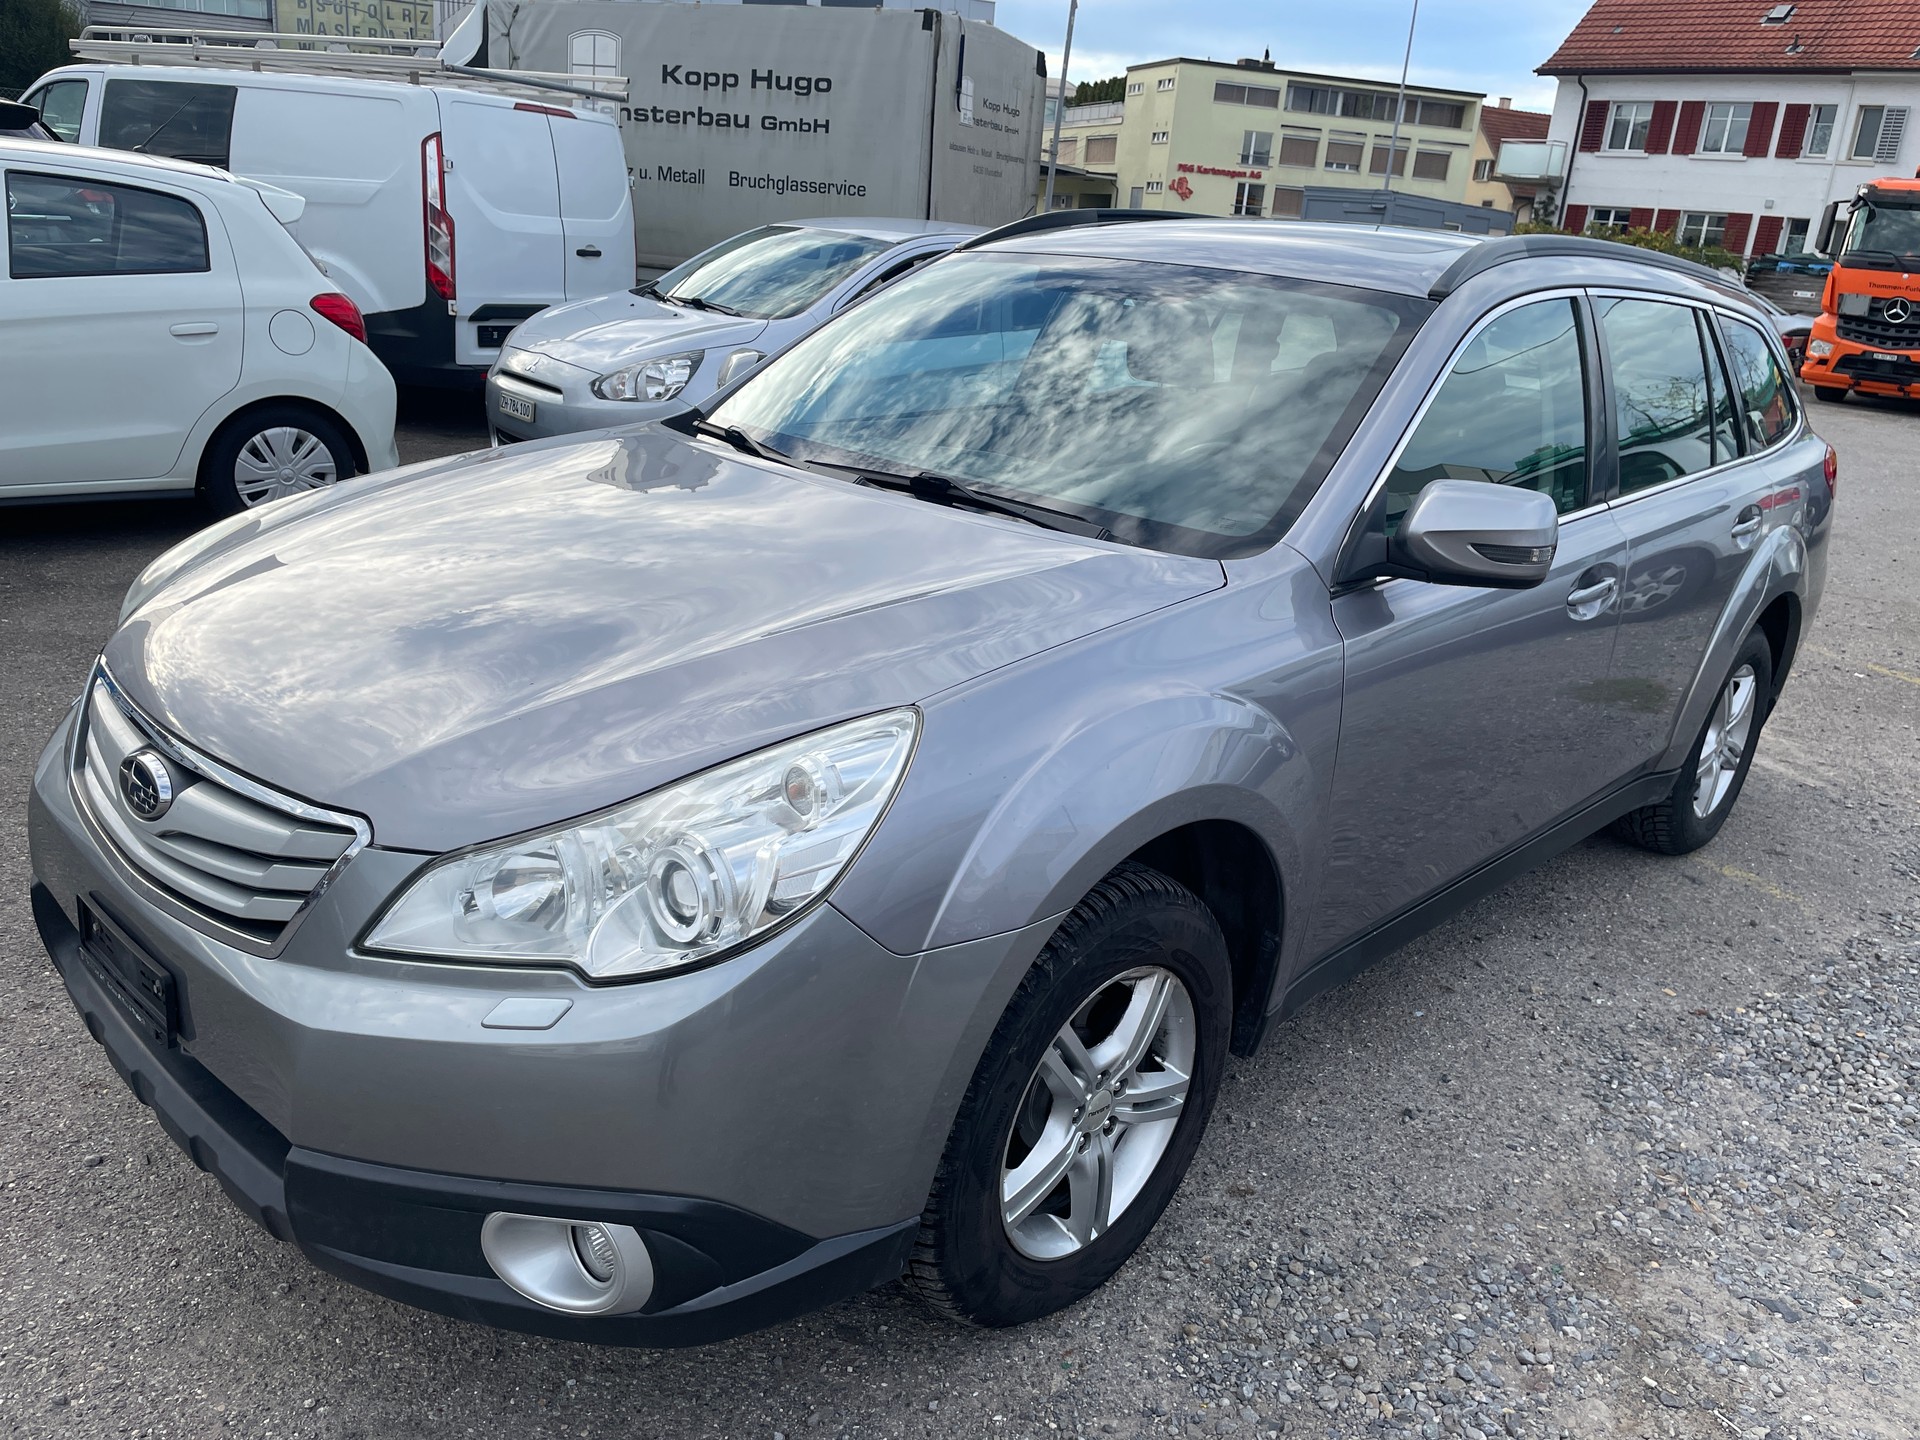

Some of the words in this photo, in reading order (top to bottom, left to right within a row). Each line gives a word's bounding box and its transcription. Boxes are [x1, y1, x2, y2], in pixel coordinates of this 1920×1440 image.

[661, 64, 740, 92] Kopp
[750, 68, 832, 97] Hugo
[983, 98, 1000, 113] Kopp
[1003, 102, 1020, 117] Hugo
[760, 115, 831, 134] GmbH
[639, 167, 652, 180] u.
[657, 165, 706, 185] Metall
[729, 171, 867, 197] Bruchglasservice
[1248, 171, 1262, 179] AG
